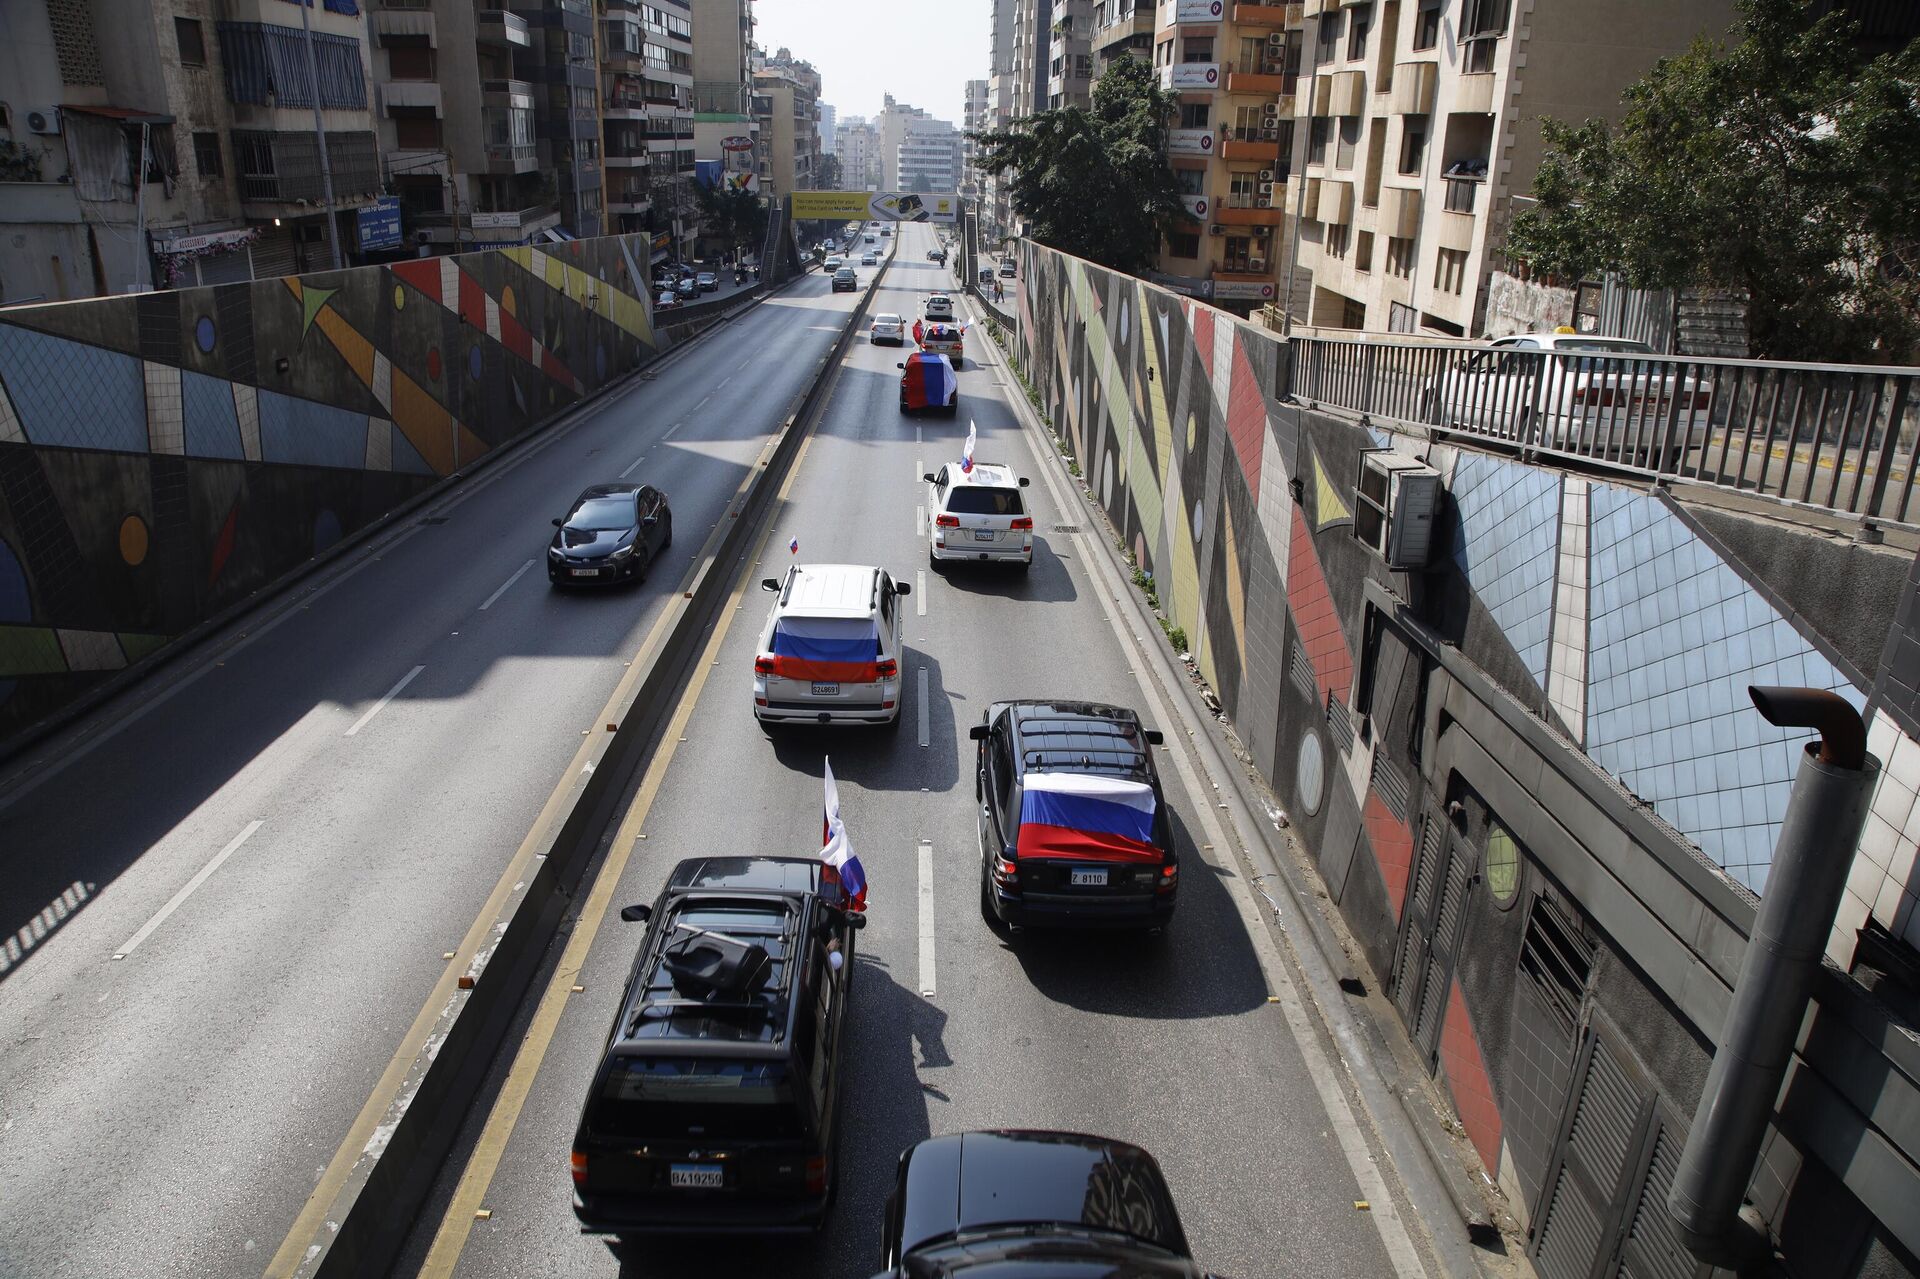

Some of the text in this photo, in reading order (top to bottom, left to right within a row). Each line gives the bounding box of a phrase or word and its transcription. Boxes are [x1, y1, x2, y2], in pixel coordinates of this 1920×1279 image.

[180, 237, 207, 249] ACCESSORIES
[1072, 873, 1102, 884] Z 8110
[672, 1172, 722, 1185] B419259
